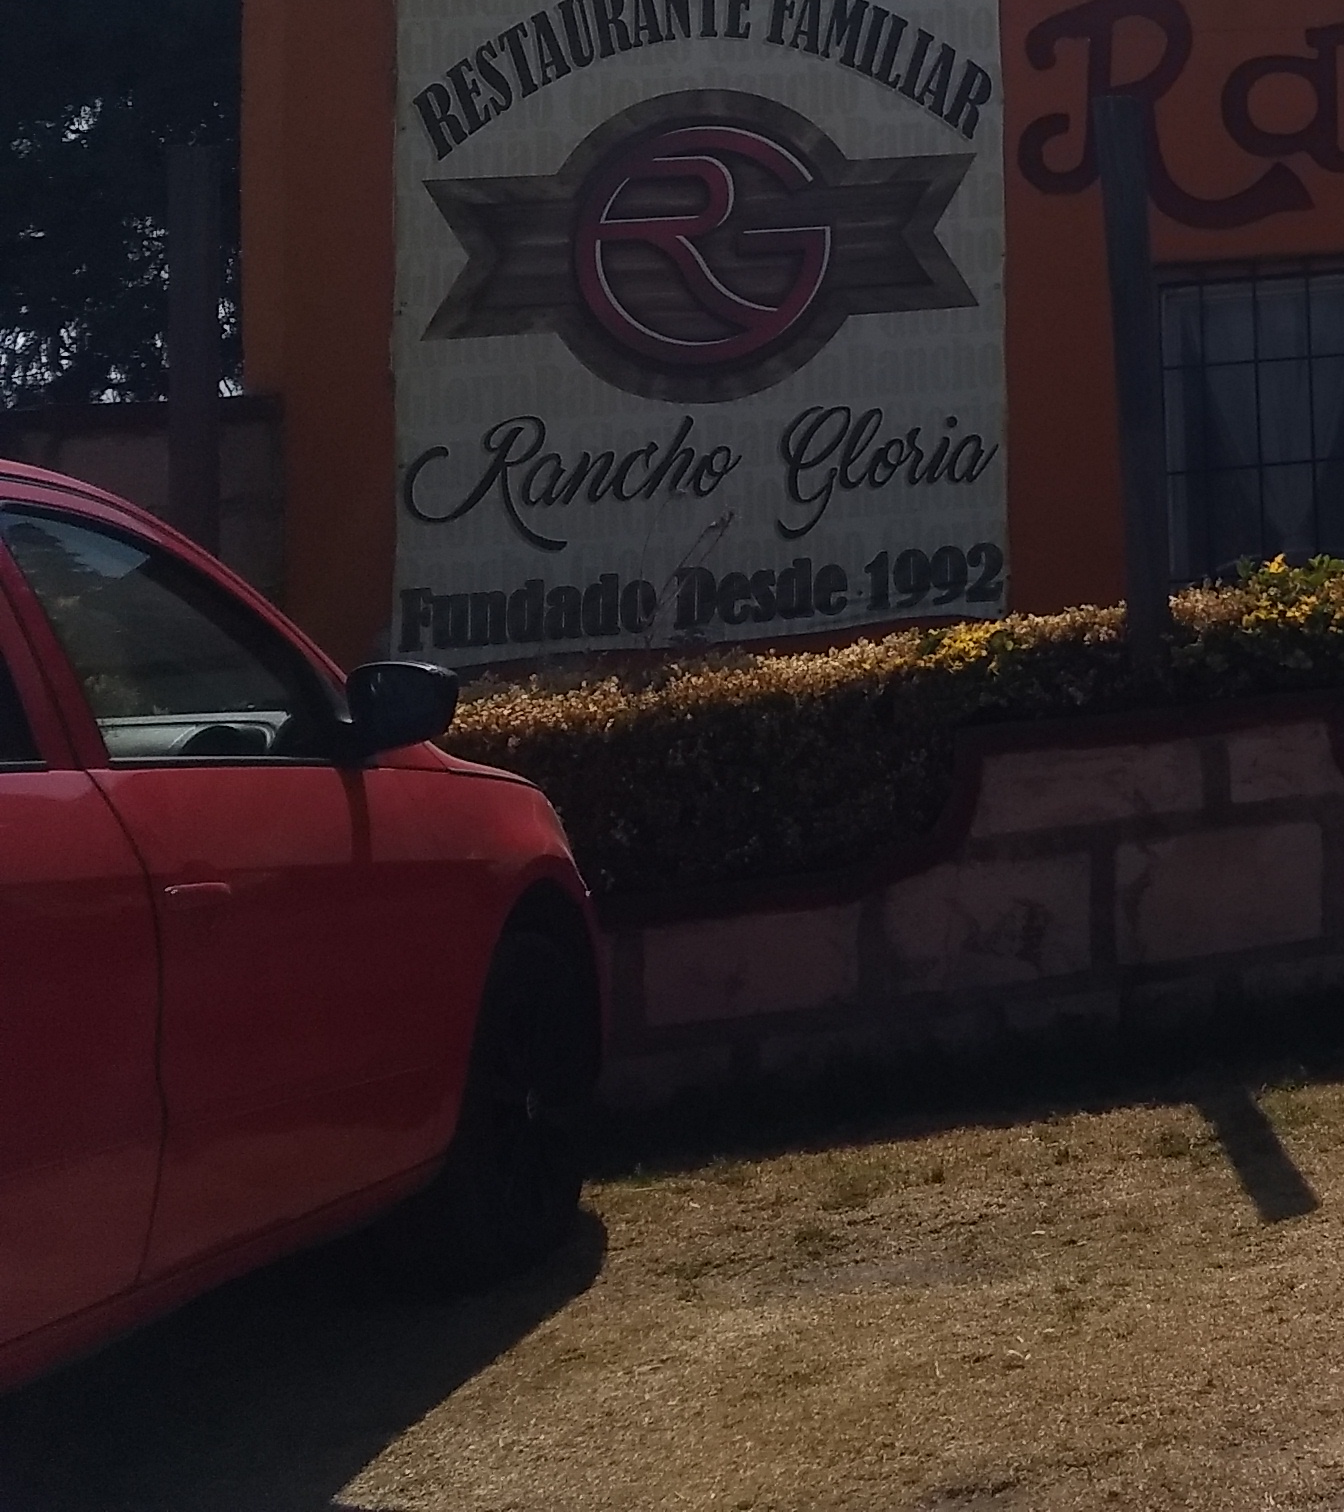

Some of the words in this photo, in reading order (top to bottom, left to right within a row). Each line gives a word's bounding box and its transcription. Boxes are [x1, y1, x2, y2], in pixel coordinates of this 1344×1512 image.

[405, 415, 741, 551] Rancho
[777, 405, 999, 539] Gloria
[399, 574, 656, 653] Fundado
[674, 557, 847, 632] Desde
[864, 542, 1005, 612] 1992
